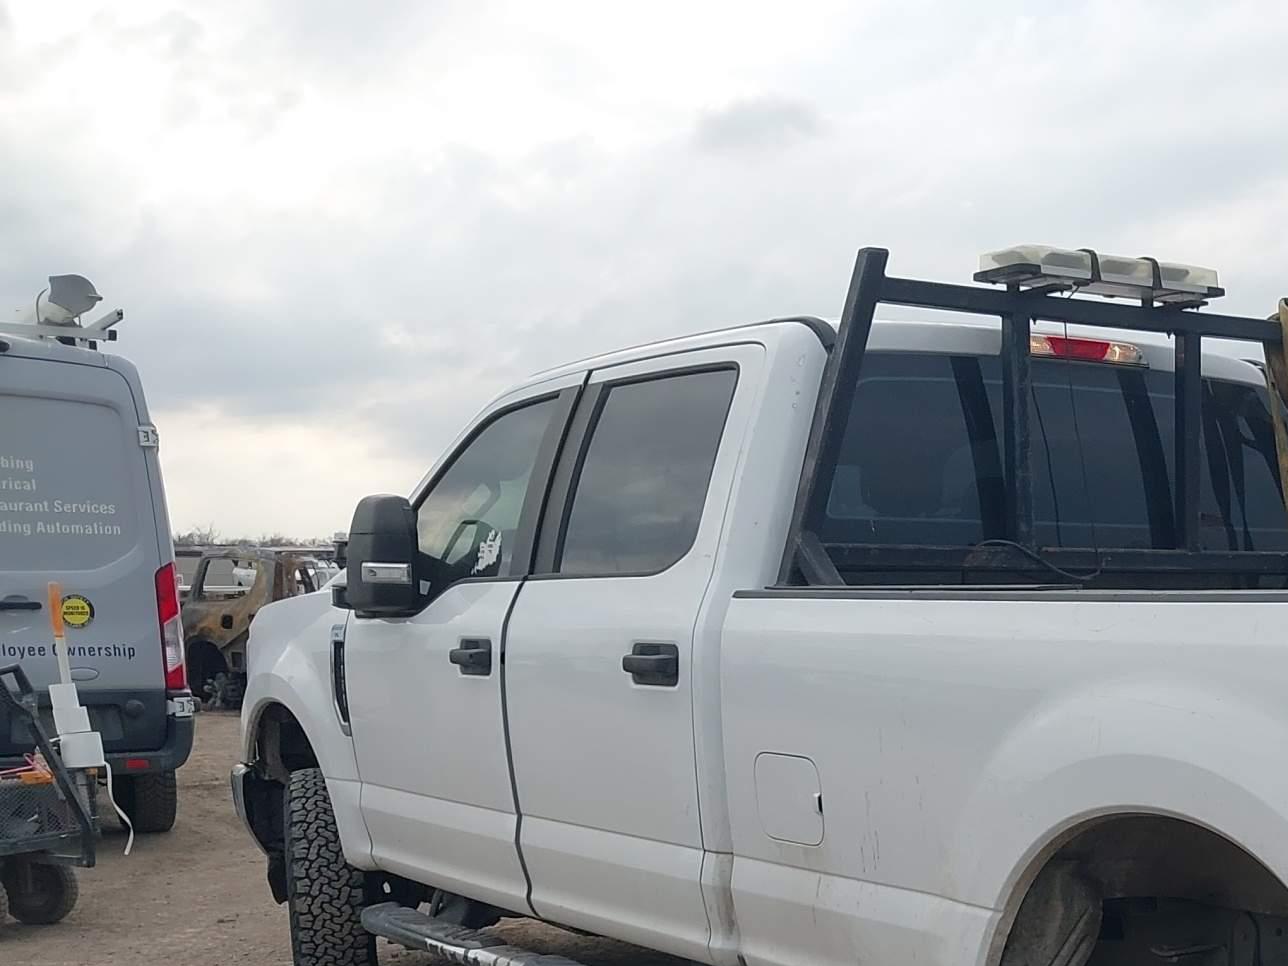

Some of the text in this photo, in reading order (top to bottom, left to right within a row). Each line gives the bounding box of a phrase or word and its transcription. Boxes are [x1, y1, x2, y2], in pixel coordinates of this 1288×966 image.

[0, 456, 34, 473] bing
[2, 477, 37, 491] rical
[0, 500, 116, 514] aurant Services
[36, 521, 121, 536] Automation
[2, 643, 47, 660] loyee
